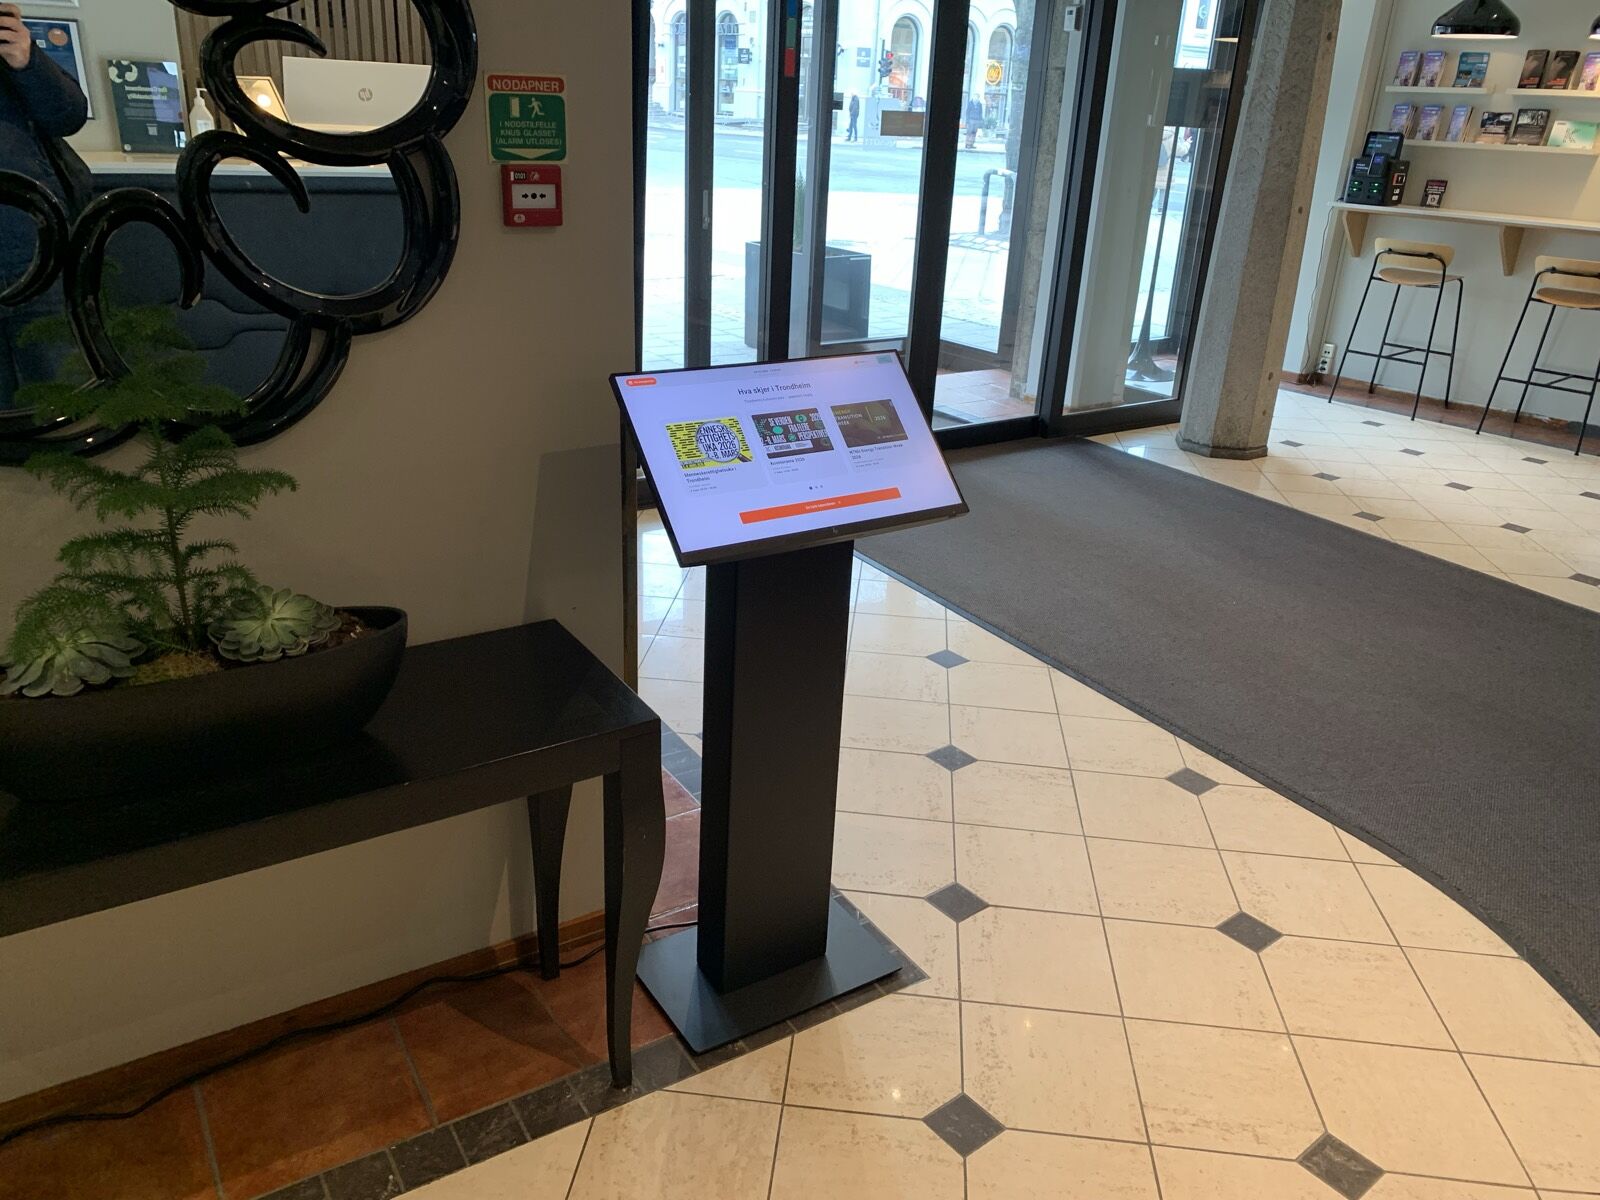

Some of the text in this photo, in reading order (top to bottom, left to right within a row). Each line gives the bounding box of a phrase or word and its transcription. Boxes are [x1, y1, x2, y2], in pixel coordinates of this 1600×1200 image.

[752, 386, 771, 394] skjer
[775, 382, 811, 391] Trondheim
[718, 440, 737, 450] 2026
